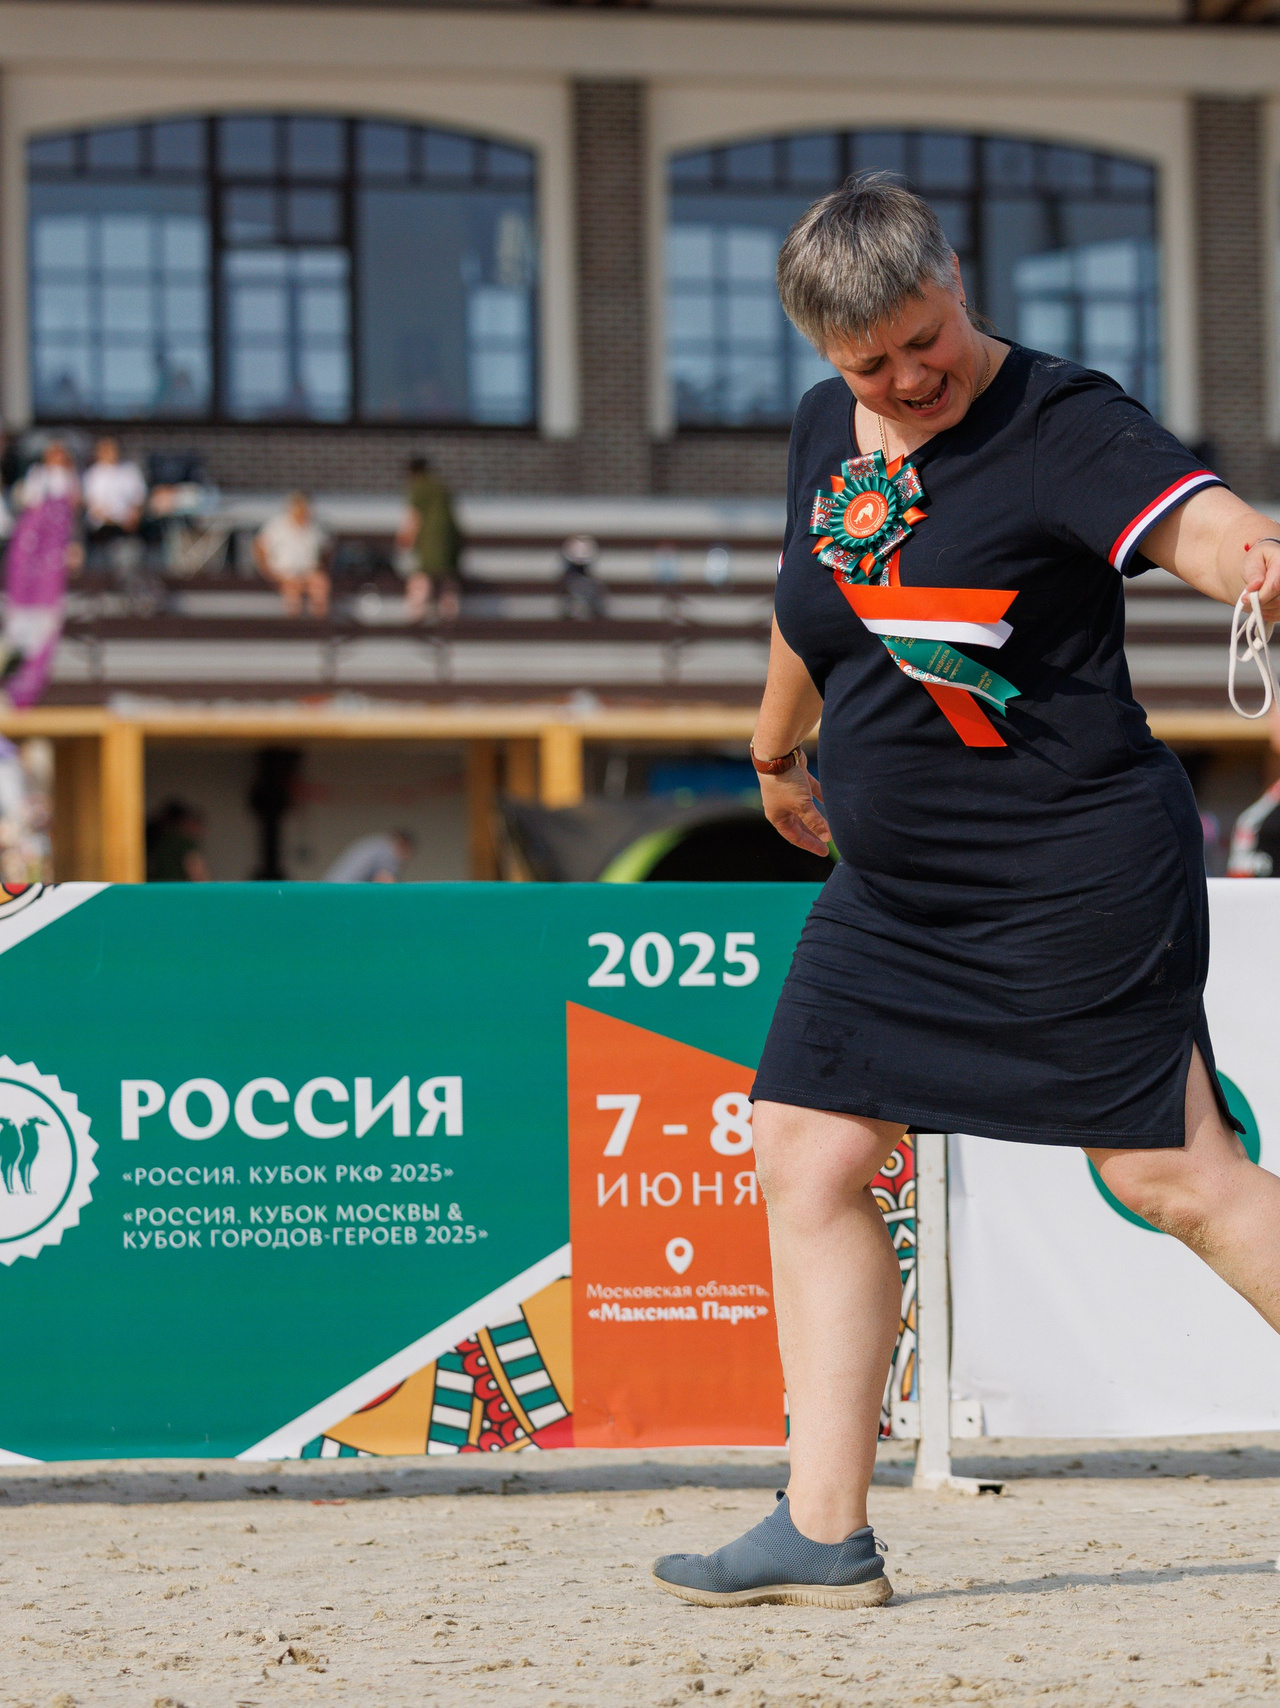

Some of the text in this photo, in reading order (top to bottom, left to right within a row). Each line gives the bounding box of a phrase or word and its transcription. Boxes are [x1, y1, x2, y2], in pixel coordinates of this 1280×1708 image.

[587, 931, 760, 988] 2025
[121, 1075, 464, 1141] РОССИЯ
[596, 1094, 642, 1157] 7
[709, 1092, 754, 1156] 8
[122, 1162, 455, 1186] «РОССИЯ. КУБОК РКФ 2025»
[597, 1171, 758, 1208] ИЮНЯ
[122, 1202, 464, 1227] «РОССИЯ. КУБОК МОСКВЫ &
[123, 1224, 489, 1249] КУБОК ГОРОДОВ-ГЕРОЕВ 2025»
[586, 1280, 770, 1300] Московская область,
[588, 1301, 769, 1326] «Максима Парк»
